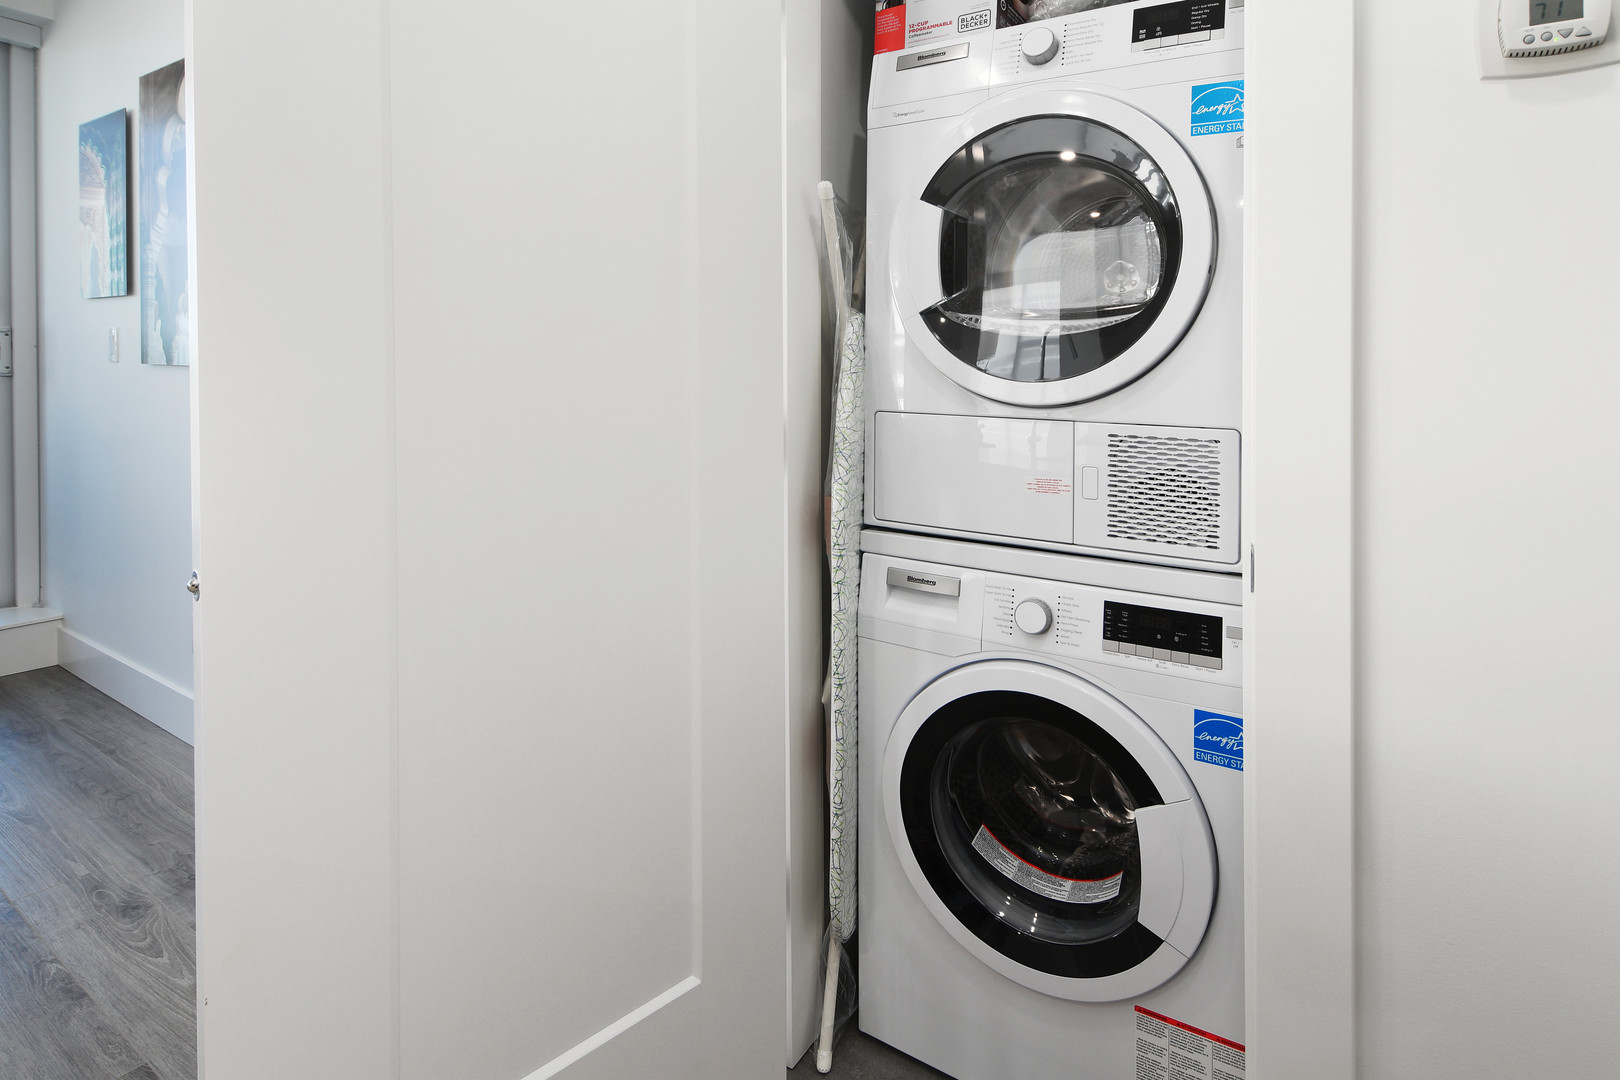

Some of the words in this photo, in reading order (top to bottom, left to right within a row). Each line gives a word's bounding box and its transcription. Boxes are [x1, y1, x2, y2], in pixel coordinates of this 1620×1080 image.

[960, 13, 988, 24] BLACK+
[908, 20, 929, 29] 12-CUP
[908, 20, 953, 34] PROGRAMMABLE
[960, 19, 988, 30] DECKER
[908, 30, 933, 39] Coffeemaker
[917, 51, 947, 61] Blomberg
[1192, 124, 1225, 135] ENERGY
[1226, 121, 1244, 132] STA
[906, 575, 937, 586] Blomberg
[1194, 731, 1236, 750] energy
[1195, 751, 1229, 765] ENERGY
